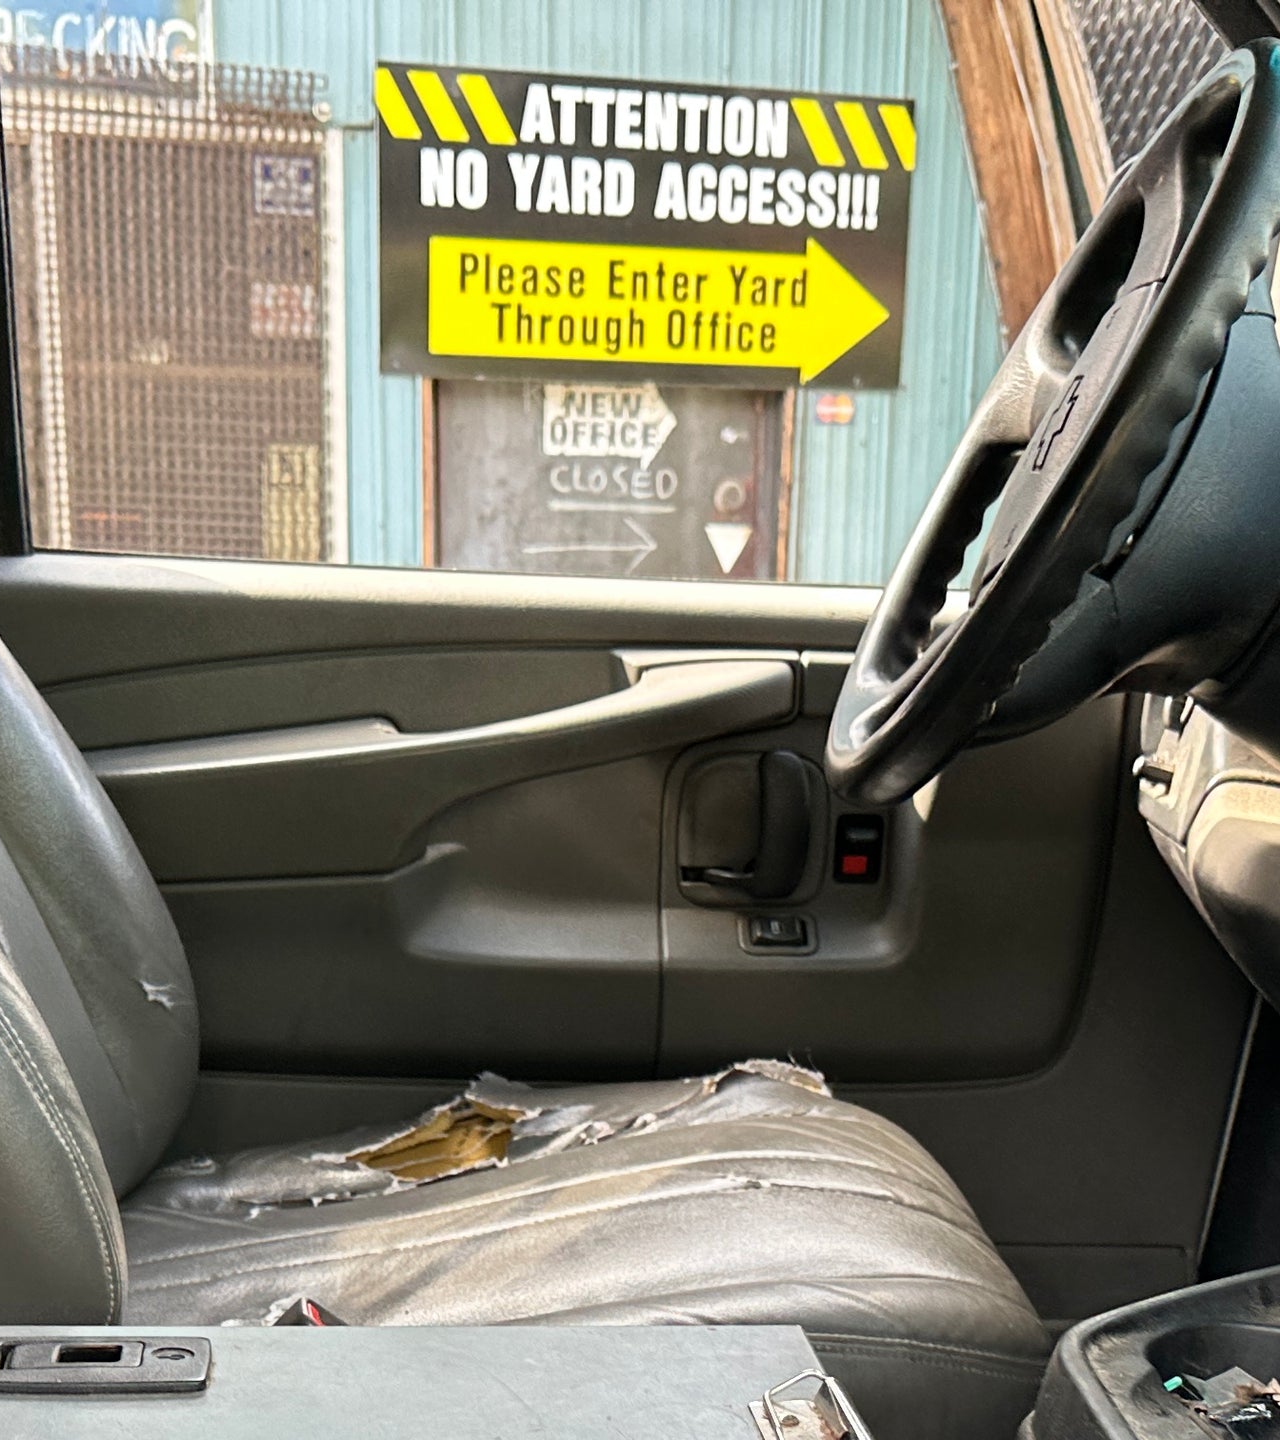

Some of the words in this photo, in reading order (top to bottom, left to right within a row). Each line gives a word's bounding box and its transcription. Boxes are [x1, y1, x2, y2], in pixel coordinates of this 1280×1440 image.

[520, 82, 789, 158] ATTENTION
[420, 147, 489, 211] NO
[508, 152, 636, 218] YARD
[653, 161, 880, 231] ACCESS!!!
[459, 252, 586, 298] Please
[608, 259, 709, 303] Enter
[729, 264, 809, 308] Yard
[490, 302, 645, 355] Through
[666, 309, 777, 354] Office
[564, 389, 643, 418] NEW
[549, 419, 660, 449] OFFICE
[548, 464, 678, 499] CLOSED
